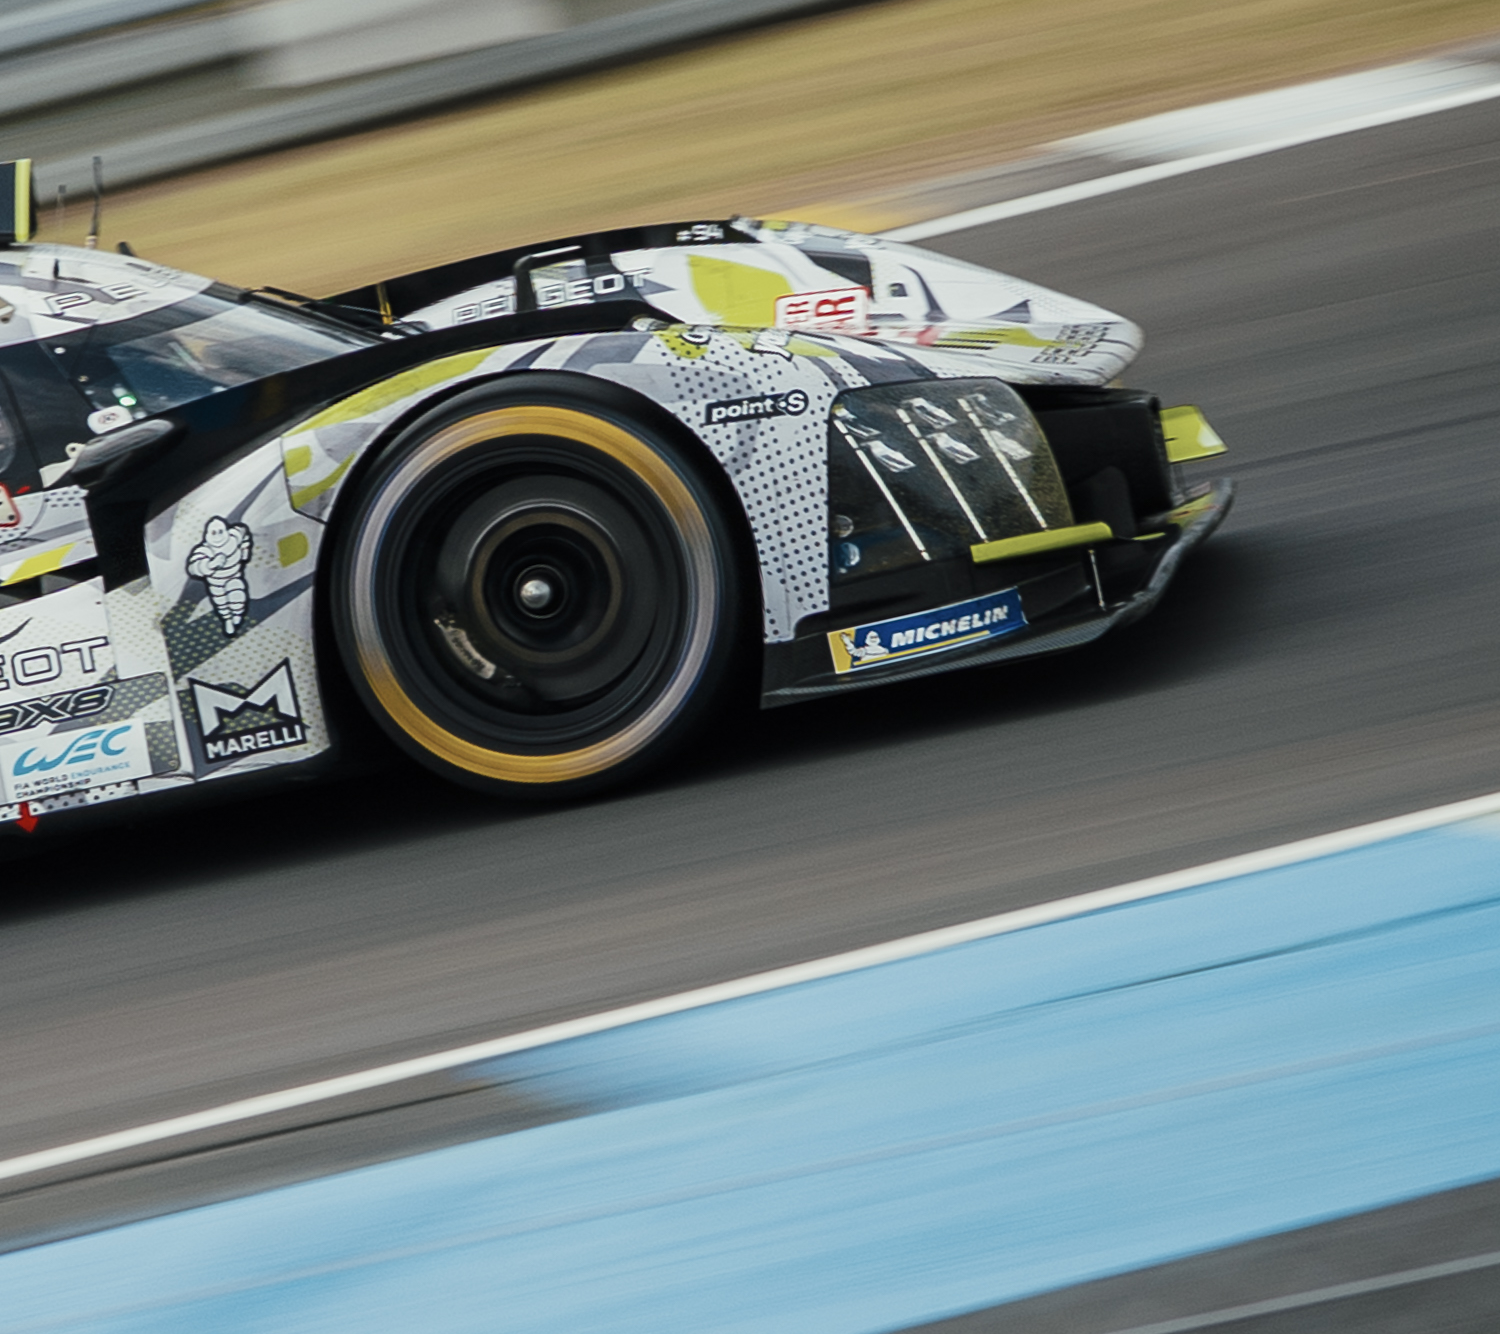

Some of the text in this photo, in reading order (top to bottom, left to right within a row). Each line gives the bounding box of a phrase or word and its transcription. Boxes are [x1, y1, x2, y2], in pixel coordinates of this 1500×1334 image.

[890, 605, 1010, 649] MICHELIN
[13, 724, 132, 777] WEC
[206, 722, 305, 761] MARELLI
